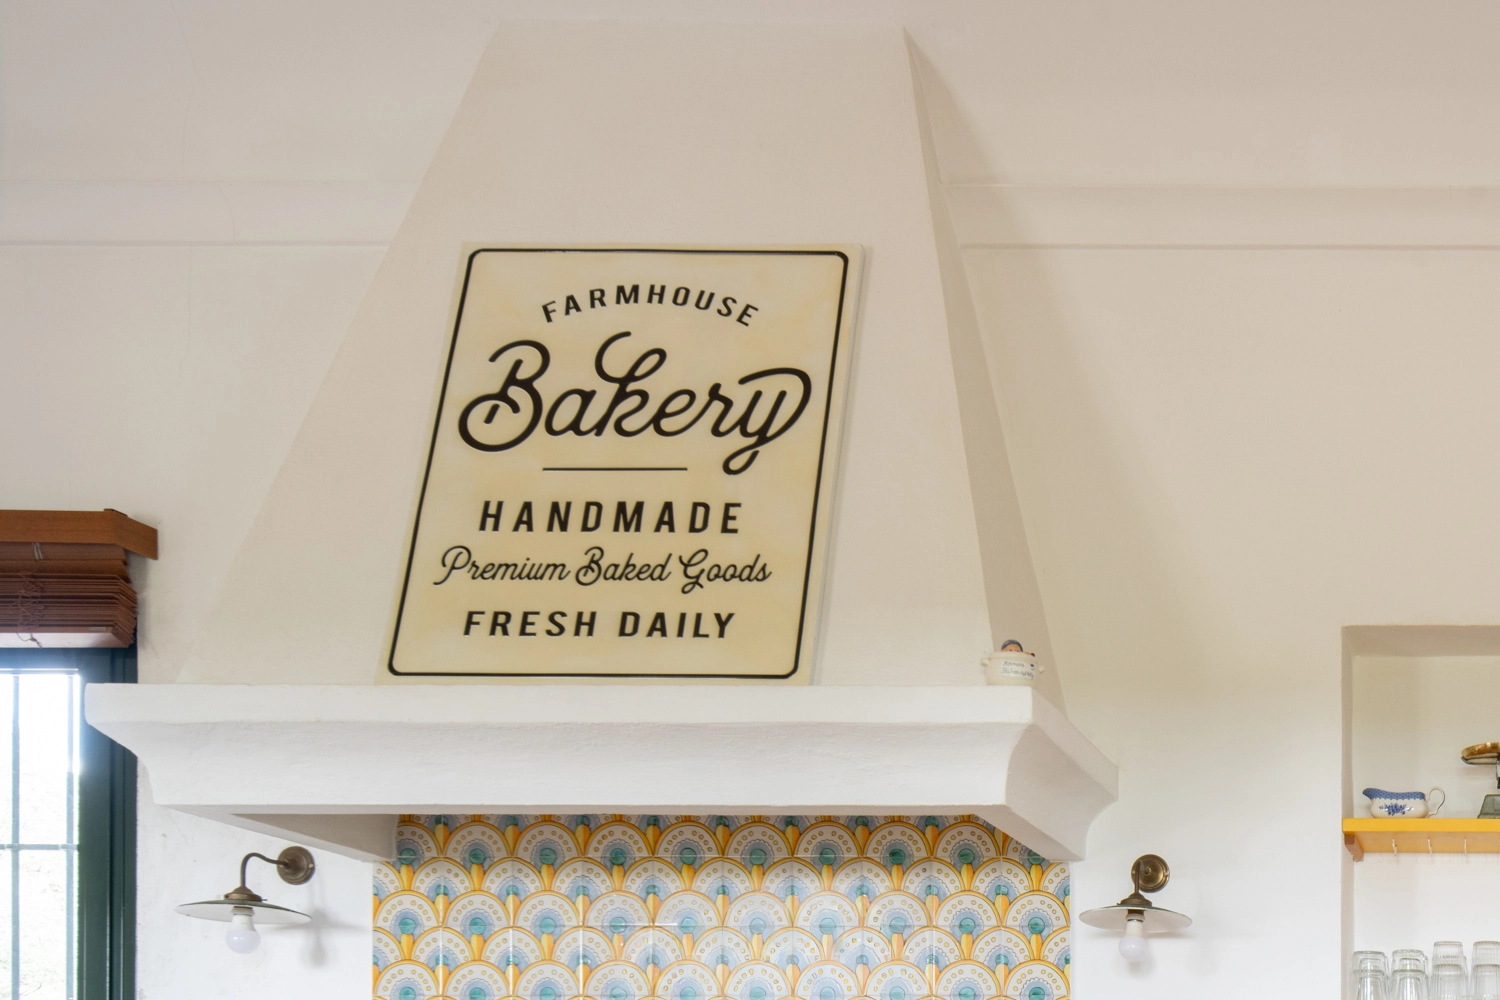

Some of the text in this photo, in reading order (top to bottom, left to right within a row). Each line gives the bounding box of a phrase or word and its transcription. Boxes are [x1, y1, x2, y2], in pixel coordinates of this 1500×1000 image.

[541, 284, 759, 327] FARMHOUSE
[458, 331, 812, 475] Bakery
[478, 500, 742, 534] HANDMADE
[432, 545, 773, 595] Premium Baked Goods
[463, 610, 736, 639] FRESH DAILY
